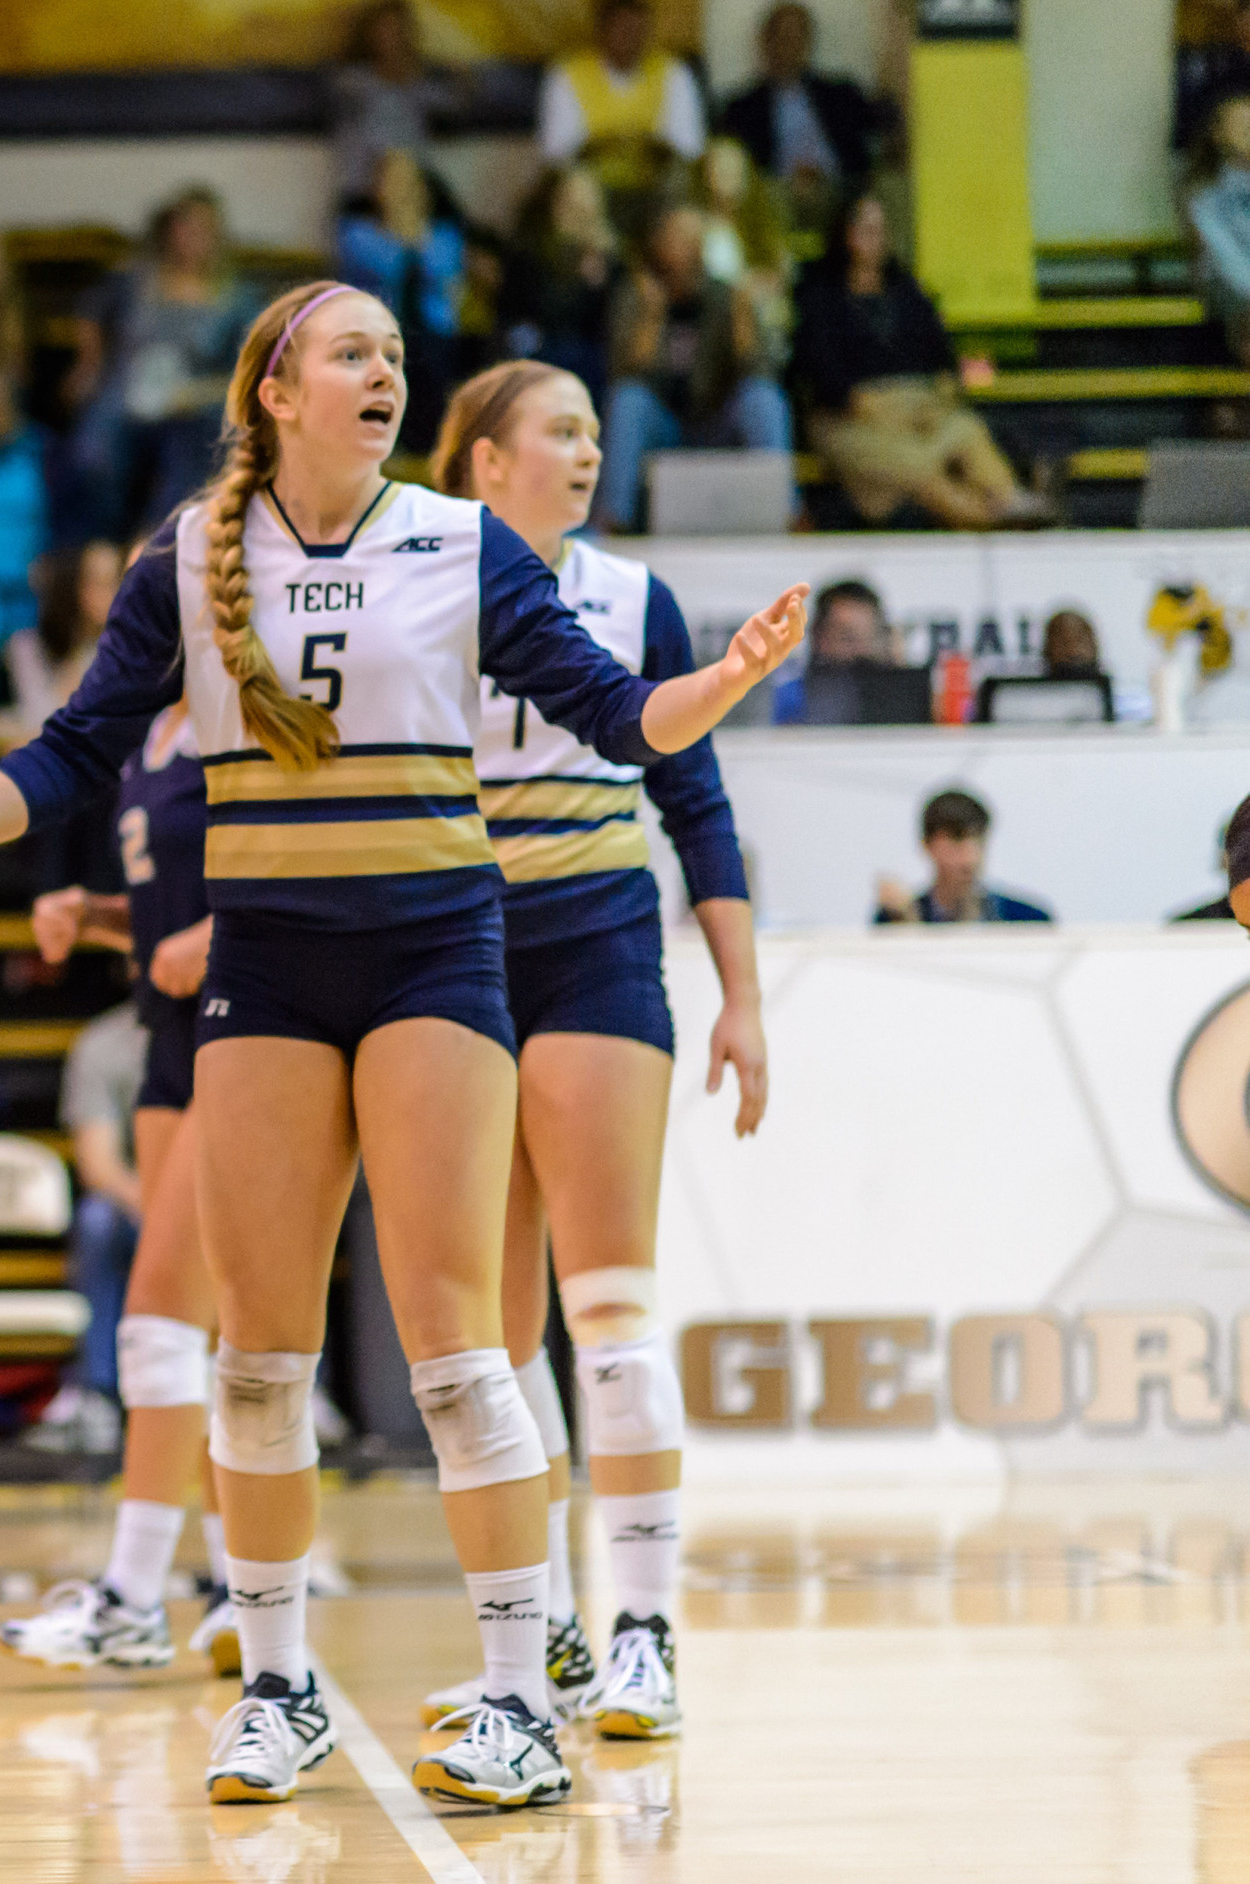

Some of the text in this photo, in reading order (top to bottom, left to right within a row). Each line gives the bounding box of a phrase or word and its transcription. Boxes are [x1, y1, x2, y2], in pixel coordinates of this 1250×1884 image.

[391, 537, 443, 553] ACC
[285, 581, 364, 614] TECH
[300, 631, 347, 712] 5
[117, 805, 156, 885] 2
[679, 1312, 1250, 1434] GEOR
